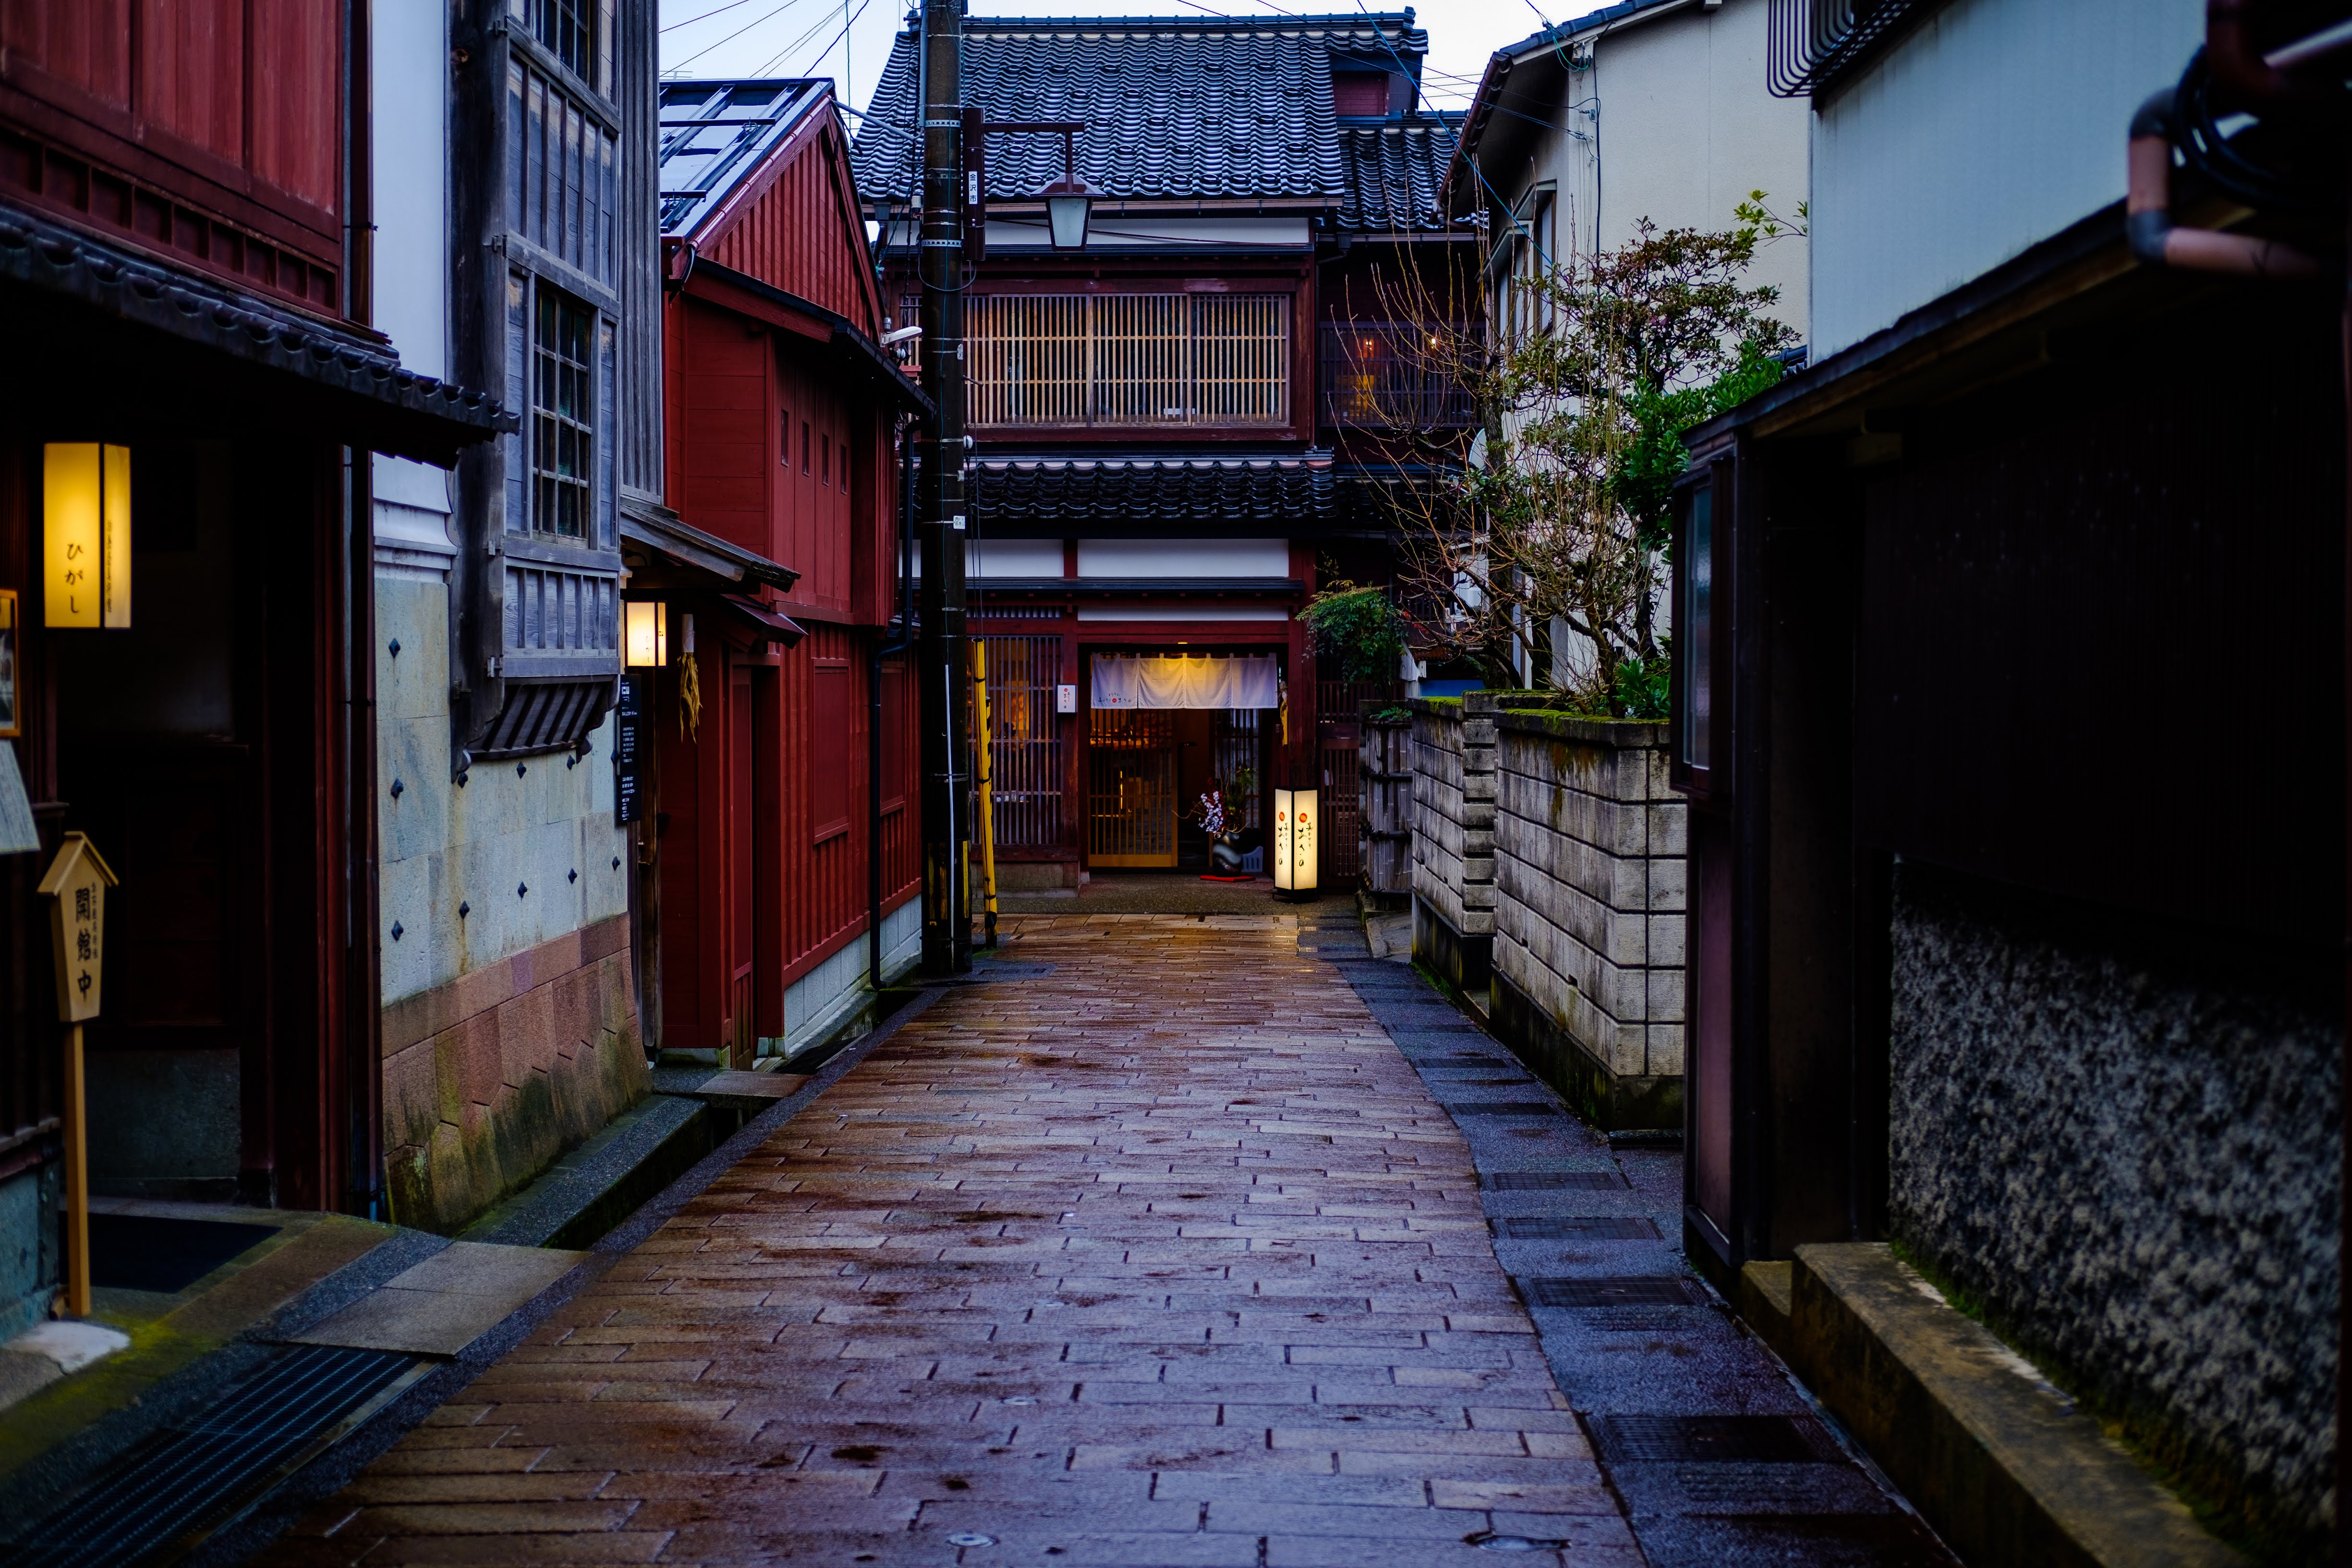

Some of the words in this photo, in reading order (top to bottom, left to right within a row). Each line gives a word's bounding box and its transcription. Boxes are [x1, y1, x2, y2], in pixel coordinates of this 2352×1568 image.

[64, 542, 84, 614] ひがし
[75, 887, 92, 1003] 開館中
